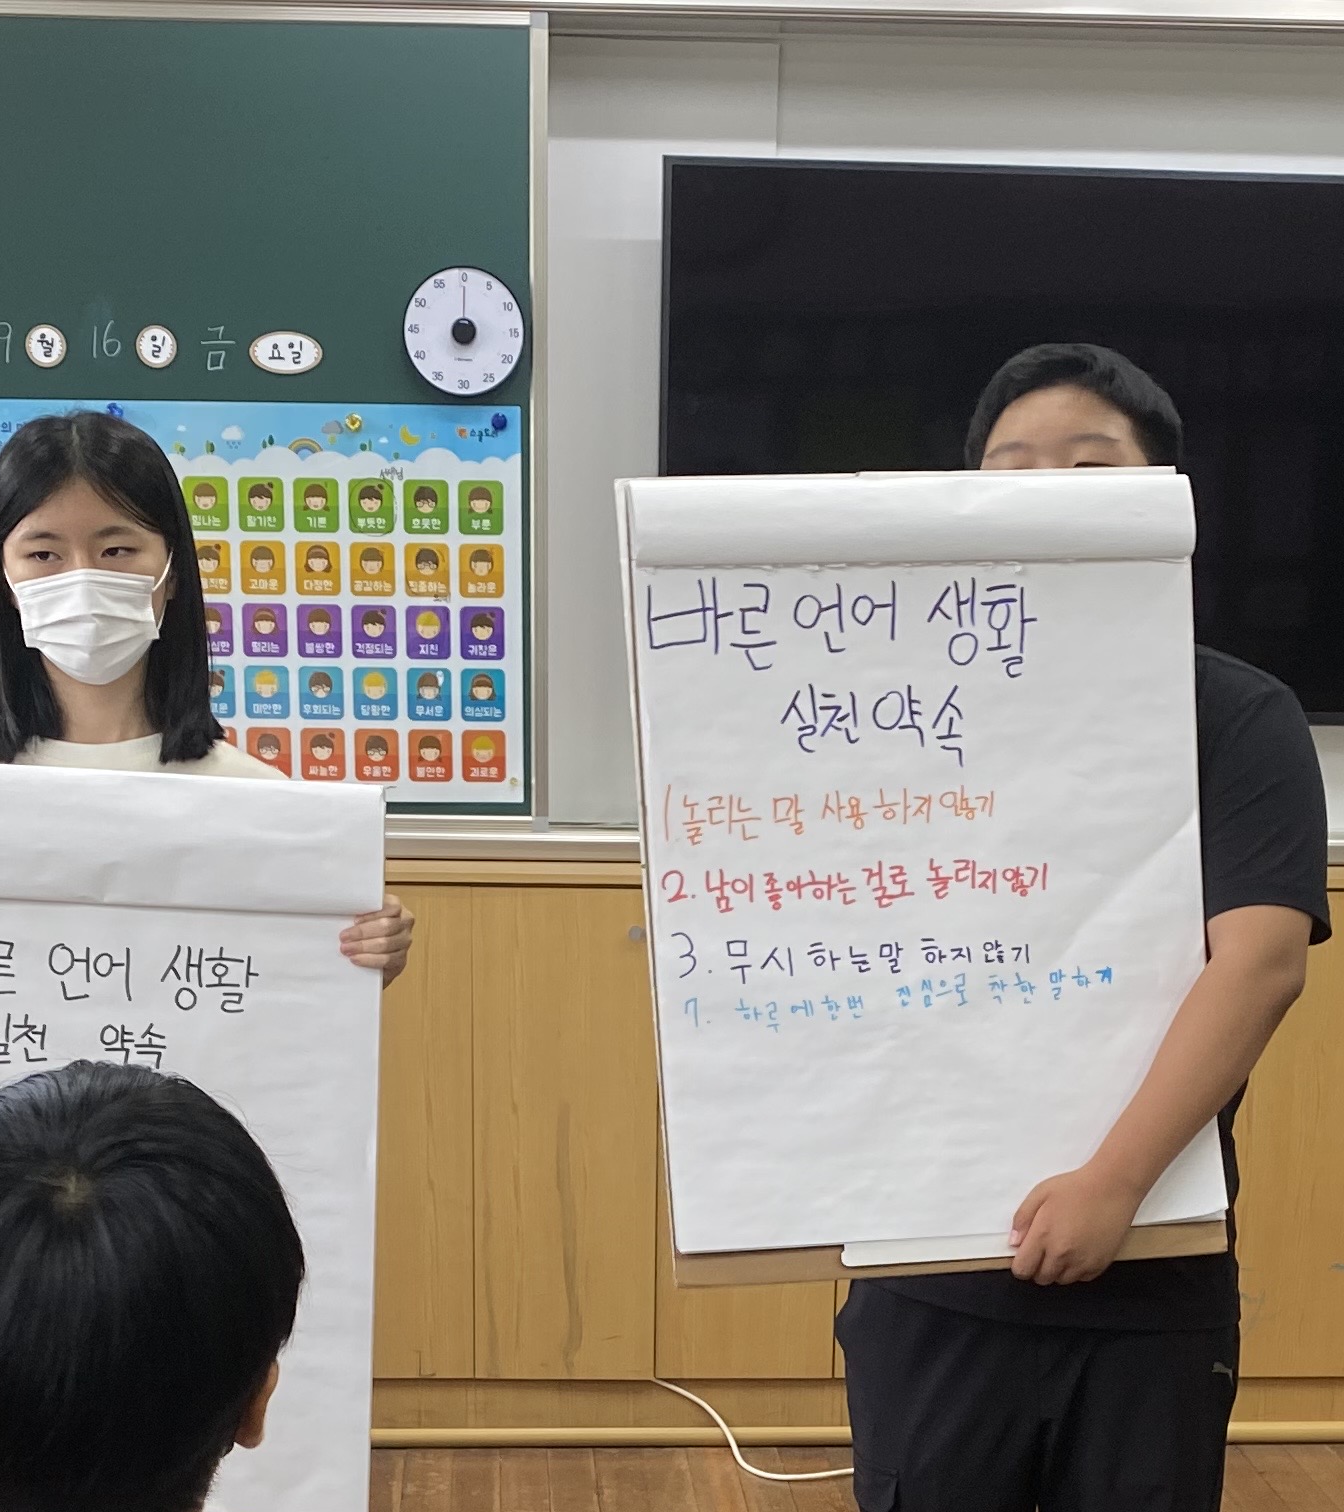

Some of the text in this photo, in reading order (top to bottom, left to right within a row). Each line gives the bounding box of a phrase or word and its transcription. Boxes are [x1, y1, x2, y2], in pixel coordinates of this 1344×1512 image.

[461, 272, 468, 282] 0
[433, 279, 445, 289] 55
[486, 281, 493, 291] 5
[414, 298, 426, 308] 50
[503, 301, 513, 311] 10
[407, 324, 420, 334] 45
[509, 328, 519, 338] 15
[37, 332, 55, 358] 월
[92, 320, 122, 359] 16
[150, 335, 166, 359] 일
[269, 342, 304, 365] 요일
[413, 350, 426, 360] 40
[501, 354, 513, 364] 20
[432, 371, 444, 381] 35
[483, 373, 495, 383] 25
[457, 379, 470, 389] 30
[306, 516, 327, 529] 기쁜
[249, 578, 278, 591] 고마운
[303, 579, 333, 592] 다정한
[354, 580, 392, 592] 공감하는
[467, 581, 497, 593] 놀라운
[647, 577, 1037, 677] 바른 언어 생활
[355, 642, 394, 655] 걱정되는
[419, 643, 439, 656] 지친
[253, 703, 282, 715] 미안한
[360, 704, 391, 717] 당황한
[415, 705, 445, 717] 무서운
[464, 705, 502, 718] 의심되는
[781, 683, 965, 767] 실천 약속
[362, 765, 392, 778] 우울한
[416, 766, 446, 778] 불안한
[469, 766, 498, 778] 괴로운
[683, 794, 762, 845] 놀리는
[773, 794, 805, 836] 말
[661, 870, 696, 903] 2.
[706, 868, 754, 913] 남이
[671, 932, 713, 979] 3.
[48, 942, 132, 1003] 언어
[161, 943, 259, 1013] 생활
[99, 1022, 167, 1069] 약속
